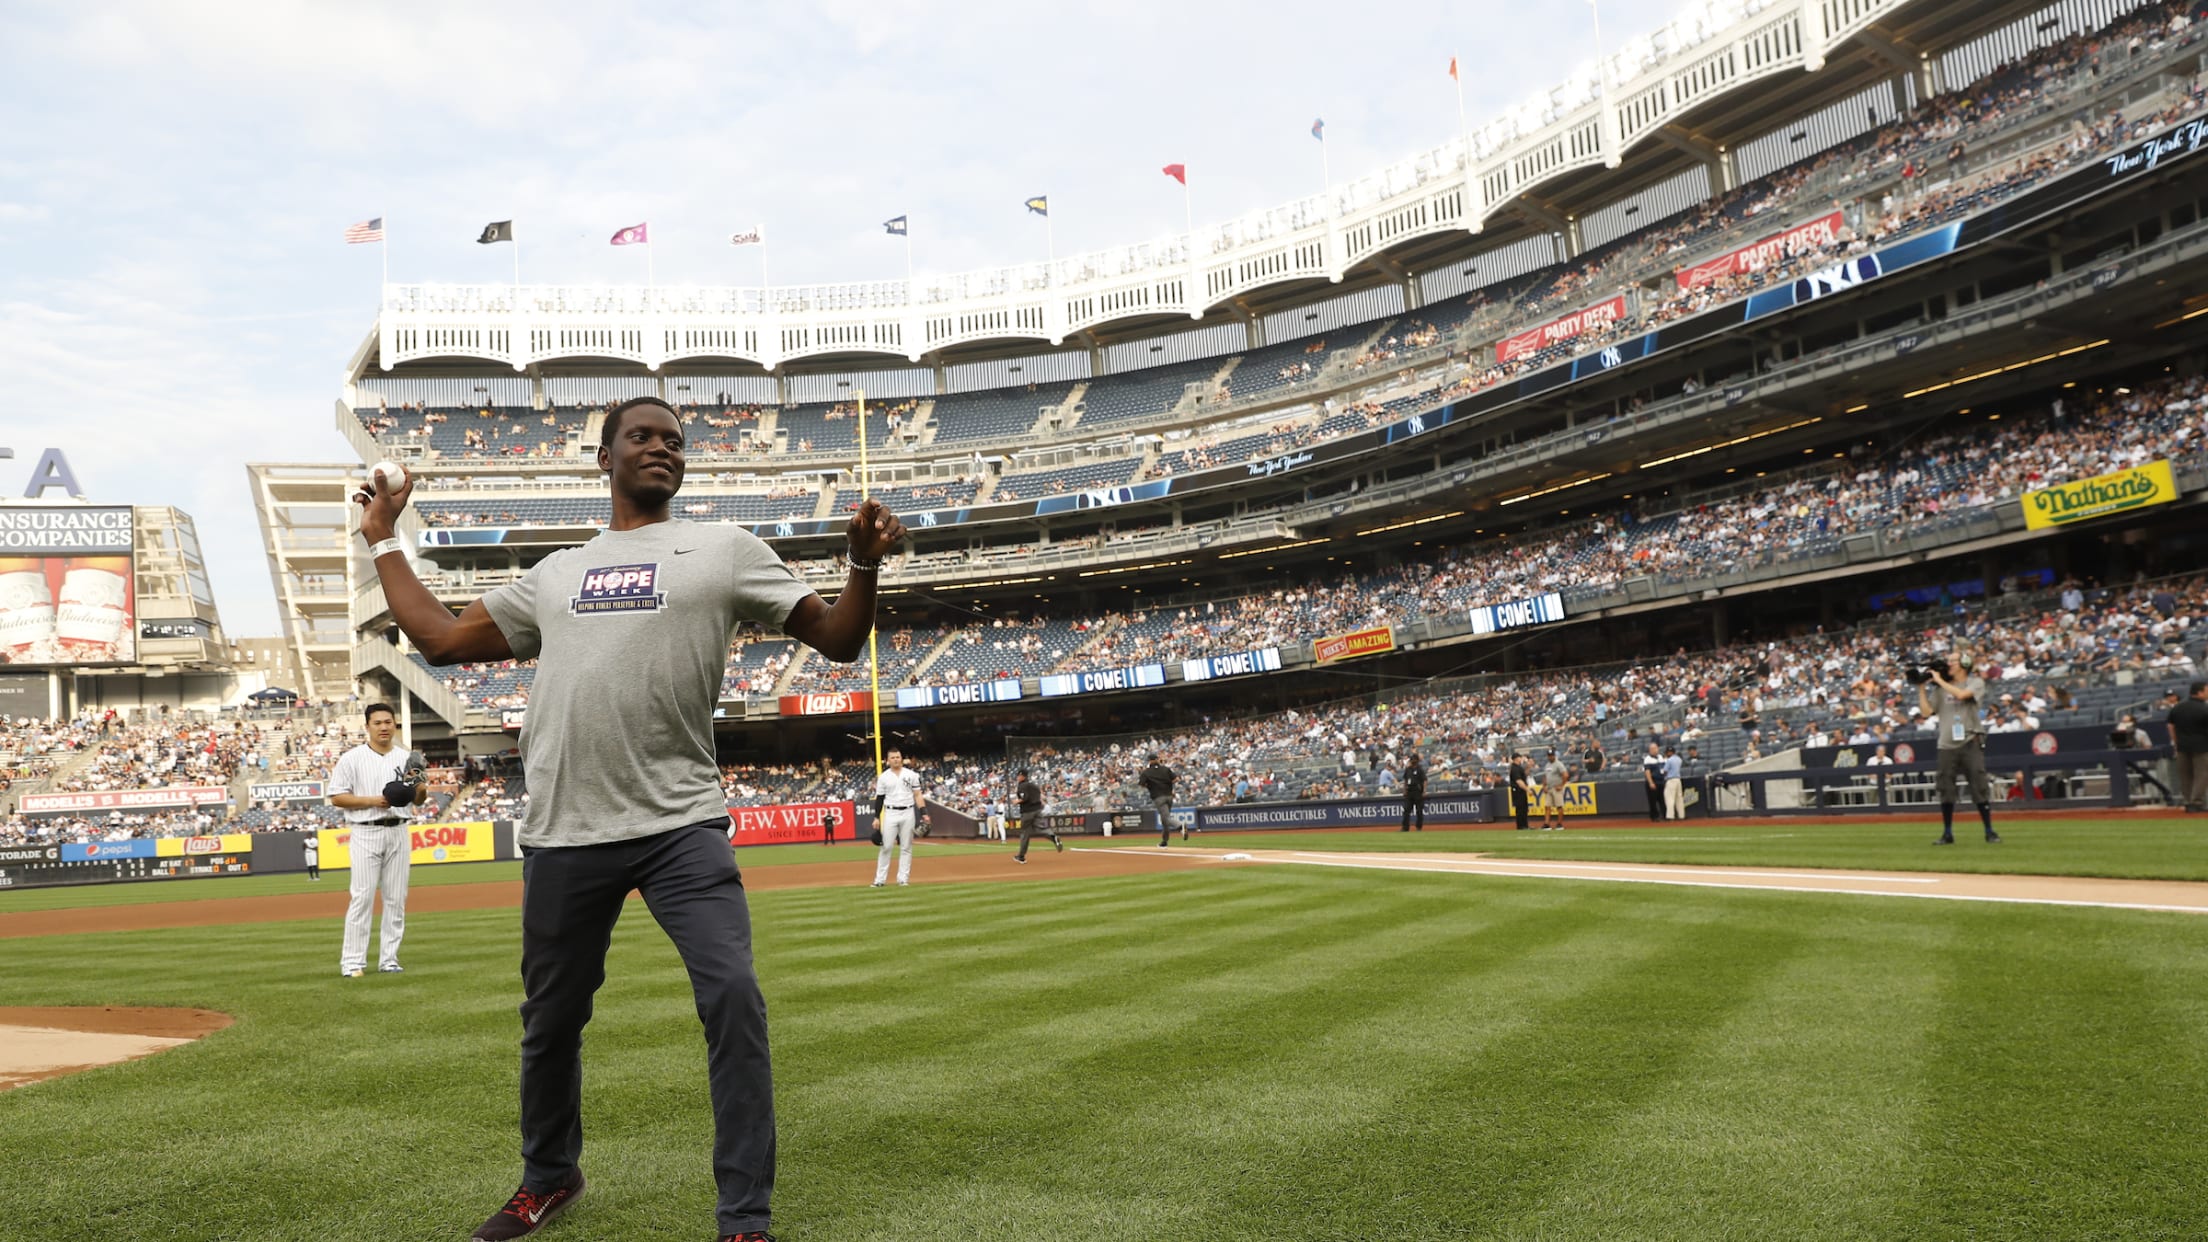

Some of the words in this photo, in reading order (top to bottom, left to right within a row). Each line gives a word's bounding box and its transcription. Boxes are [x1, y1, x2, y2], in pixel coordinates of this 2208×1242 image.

[2105, 152, 2144, 176] New
[2142, 127, 2186, 169] York
[1739, 236, 1787, 271] PARTY
[1787, 219, 1835, 256] DECK
[1545, 314, 1581, 339] PARTY
[1584, 301, 1617, 327] DECK
[2034, 472, 2157, 513] Nathan's
[585, 570, 653, 590] HOPE
[593, 588, 641, 597] WEEK
[1322, 641, 1346, 656] MIKE'S
[1349, 633, 1389, 649] AMAZING
[26, 796, 95, 809] MODELL'S
[856, 805, 870, 815] 314
[1270, 809, 1327, 821] COLLECTIBLES
[740, 810, 777, 831] F.W.
[781, 807, 844, 827] WEBB
[411, 828, 467, 850] ASON
[768, 831, 793, 839] SINCE
[102, 844, 132, 856] pepsi
[160, 860, 169, 868] AT
[190, 865, 213, 873] STRIKE
[227, 863, 241, 872] OUT
[152, 868, 169, 876] BALL
